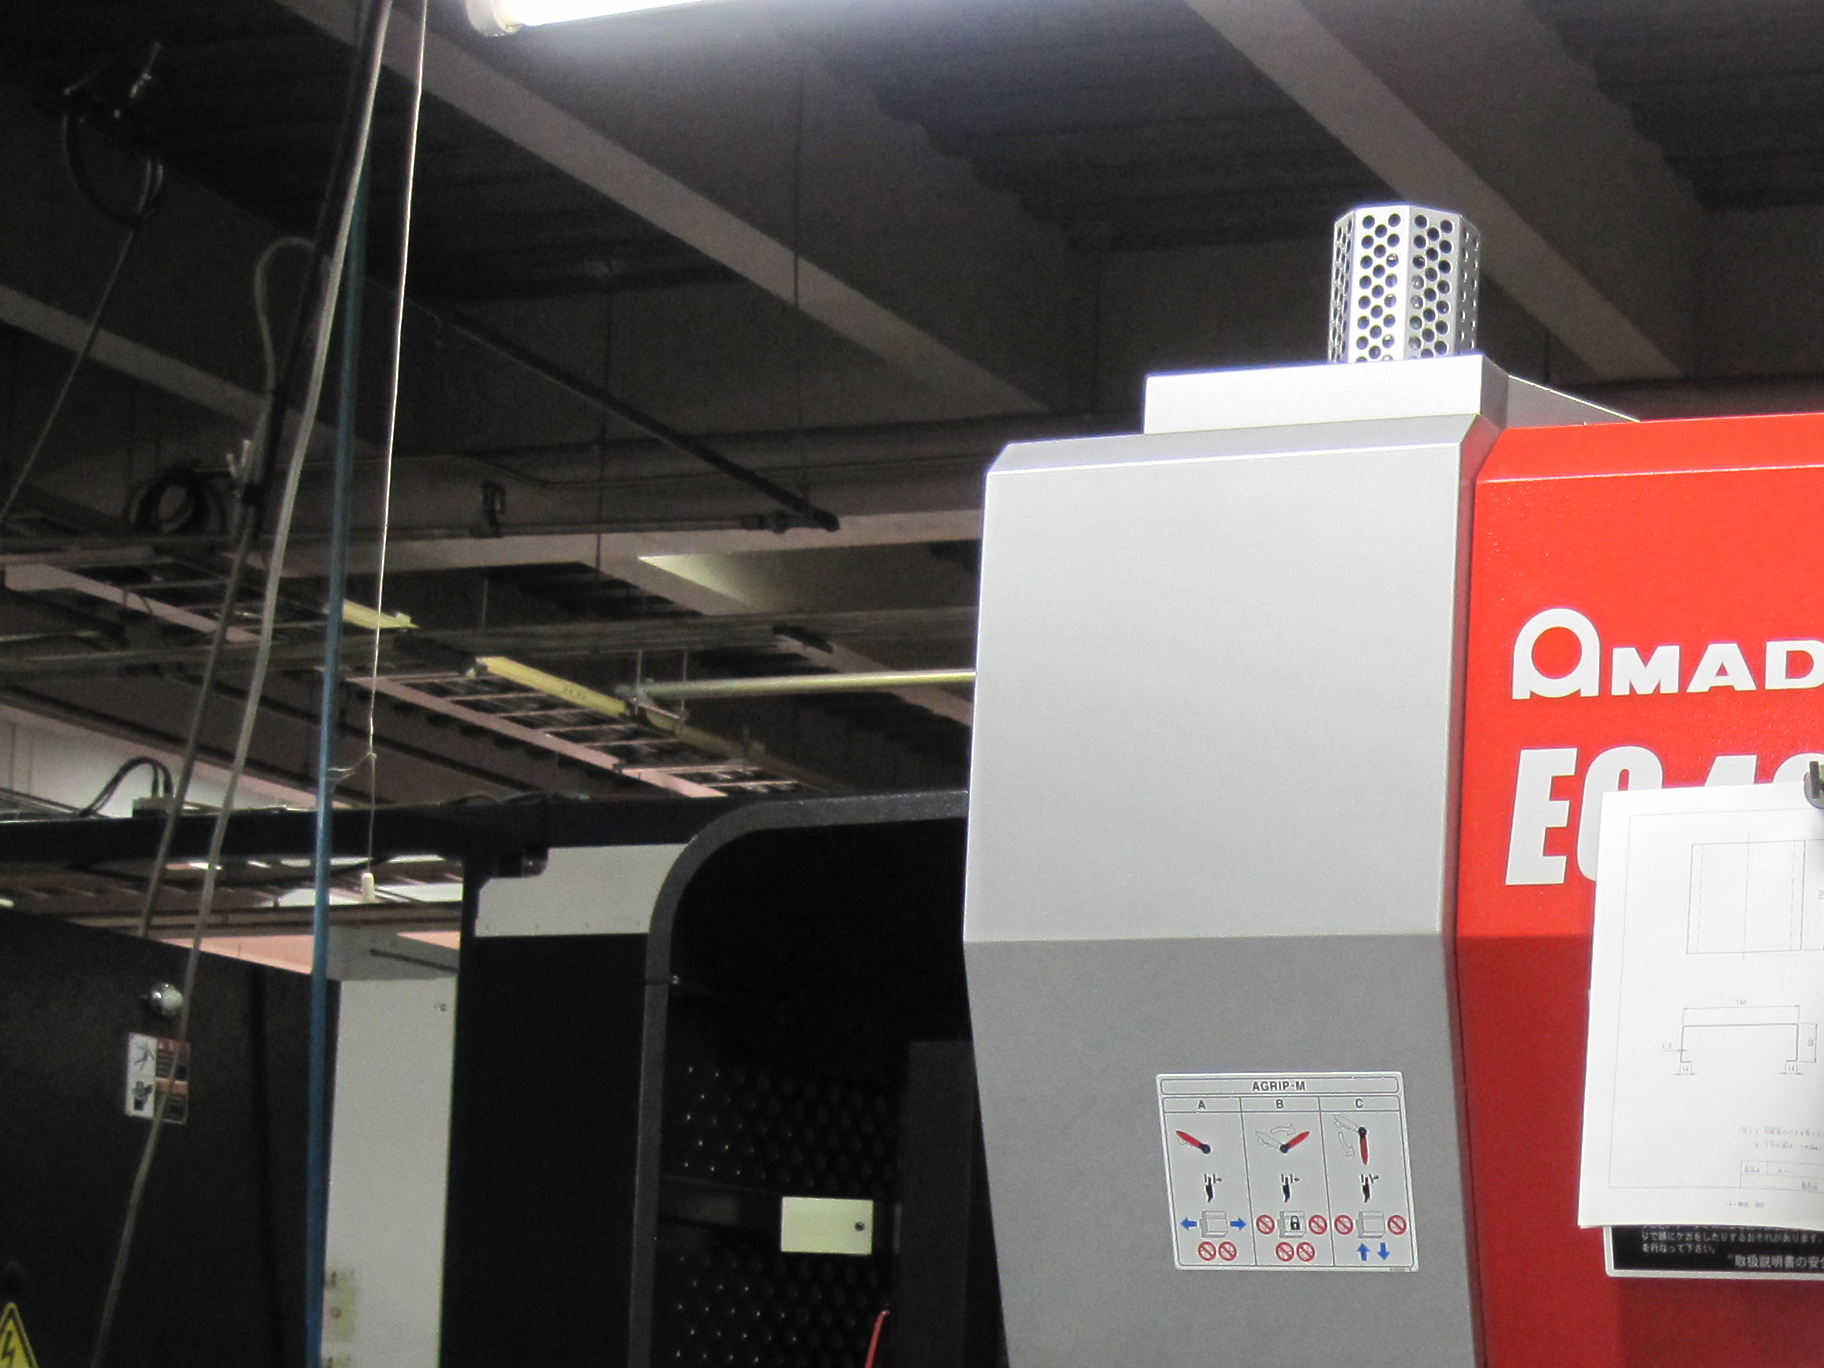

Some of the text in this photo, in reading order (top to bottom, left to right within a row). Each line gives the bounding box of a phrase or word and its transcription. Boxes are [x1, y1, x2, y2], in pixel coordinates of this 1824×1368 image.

[1252, 1080, 1306, 1091] AGRIP-M
[1197, 1099, 1206, 1110] A
[1275, 1099, 1284, 1109] B
[1354, 1098, 1364, 1109] C
